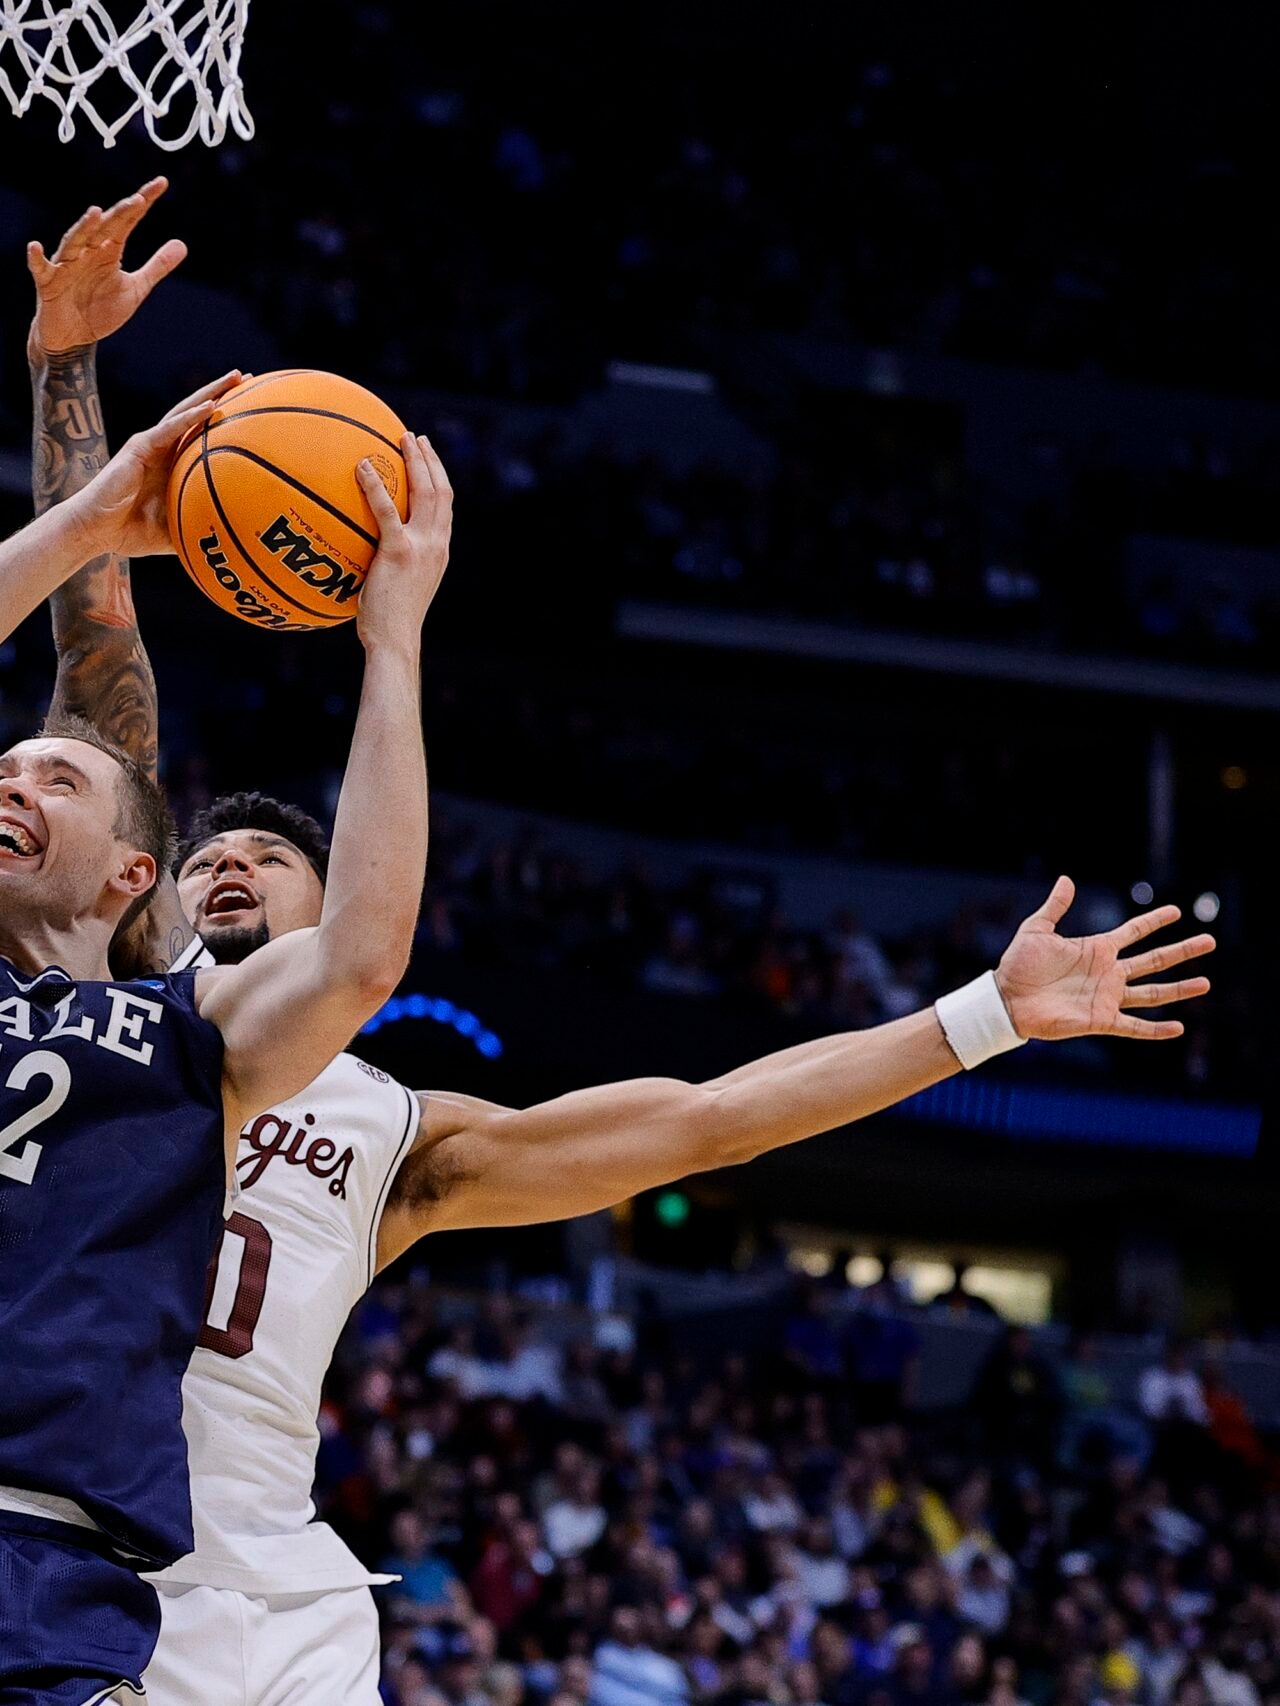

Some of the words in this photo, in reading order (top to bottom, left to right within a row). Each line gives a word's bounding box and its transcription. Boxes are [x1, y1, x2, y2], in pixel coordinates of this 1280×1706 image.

[289, 507, 314, 533] BALL
[314, 533, 342, 557] GAME
[259, 513, 364, 605] NCAA
[249, 585, 270, 602] NXT
[236, 1112, 355, 1201] gies
